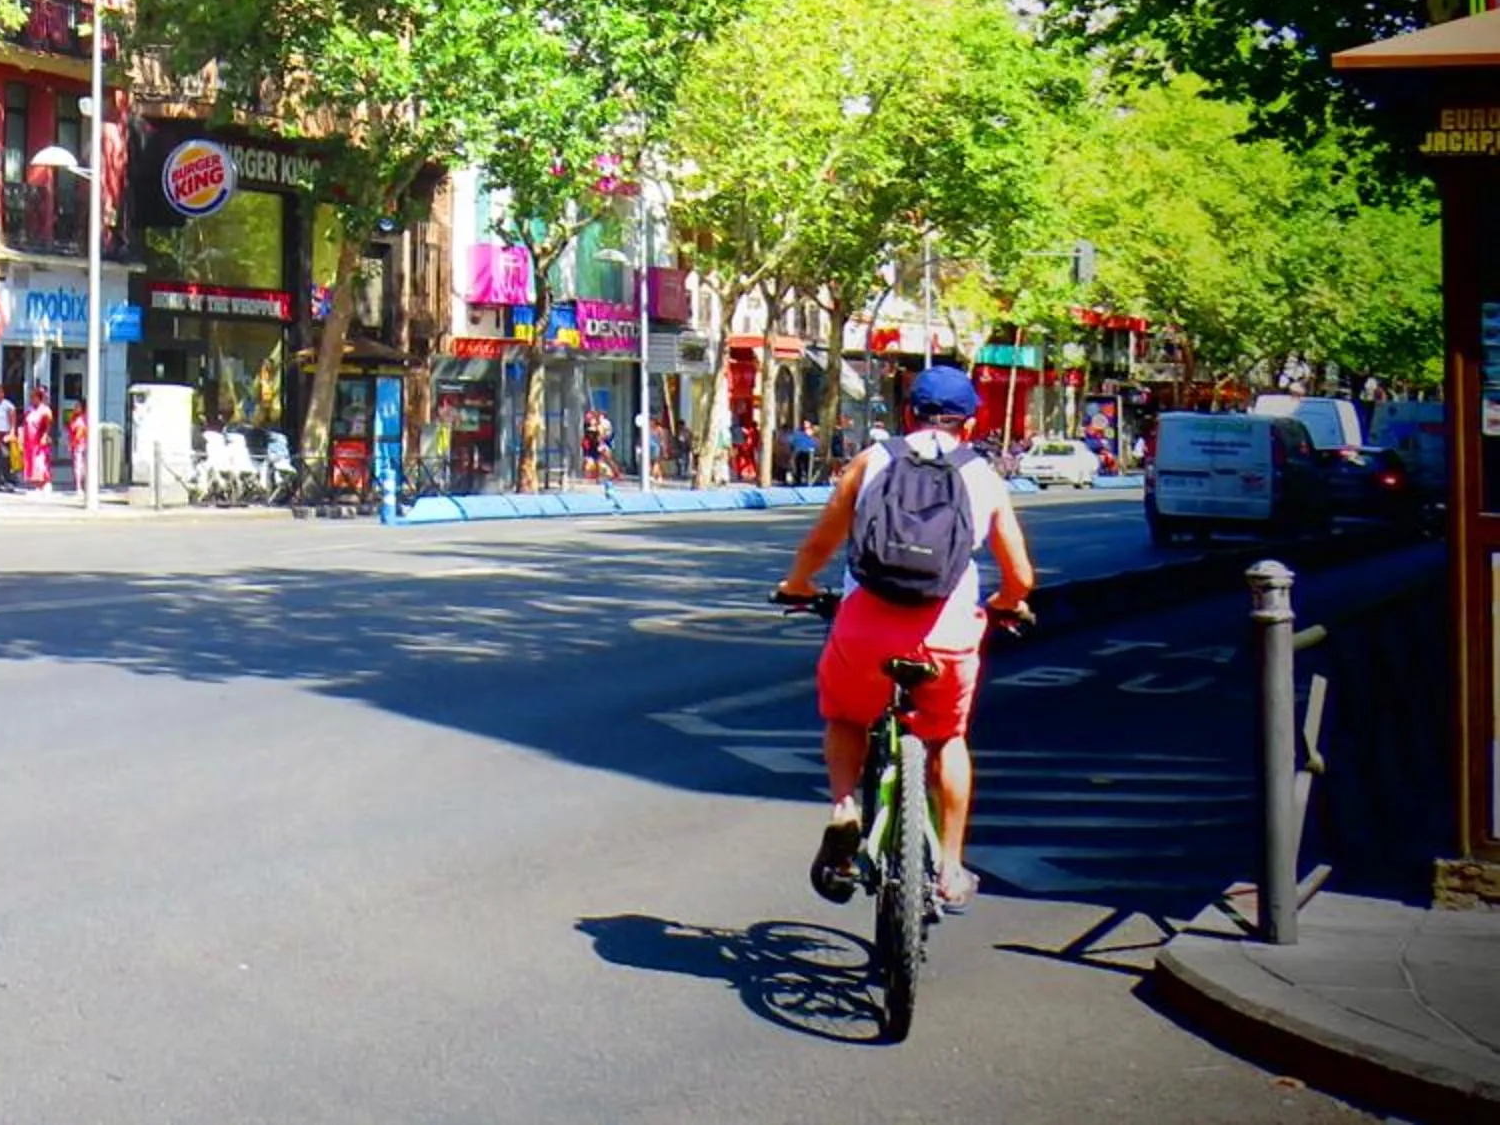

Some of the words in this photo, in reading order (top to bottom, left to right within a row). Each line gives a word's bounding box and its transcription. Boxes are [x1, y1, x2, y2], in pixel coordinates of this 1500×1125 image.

[1441, 108, 1500, 130] EURO
[1418, 130, 1500, 154] JACKP
[172, 154, 222, 182] BURGER
[174, 167, 225, 200] KING
